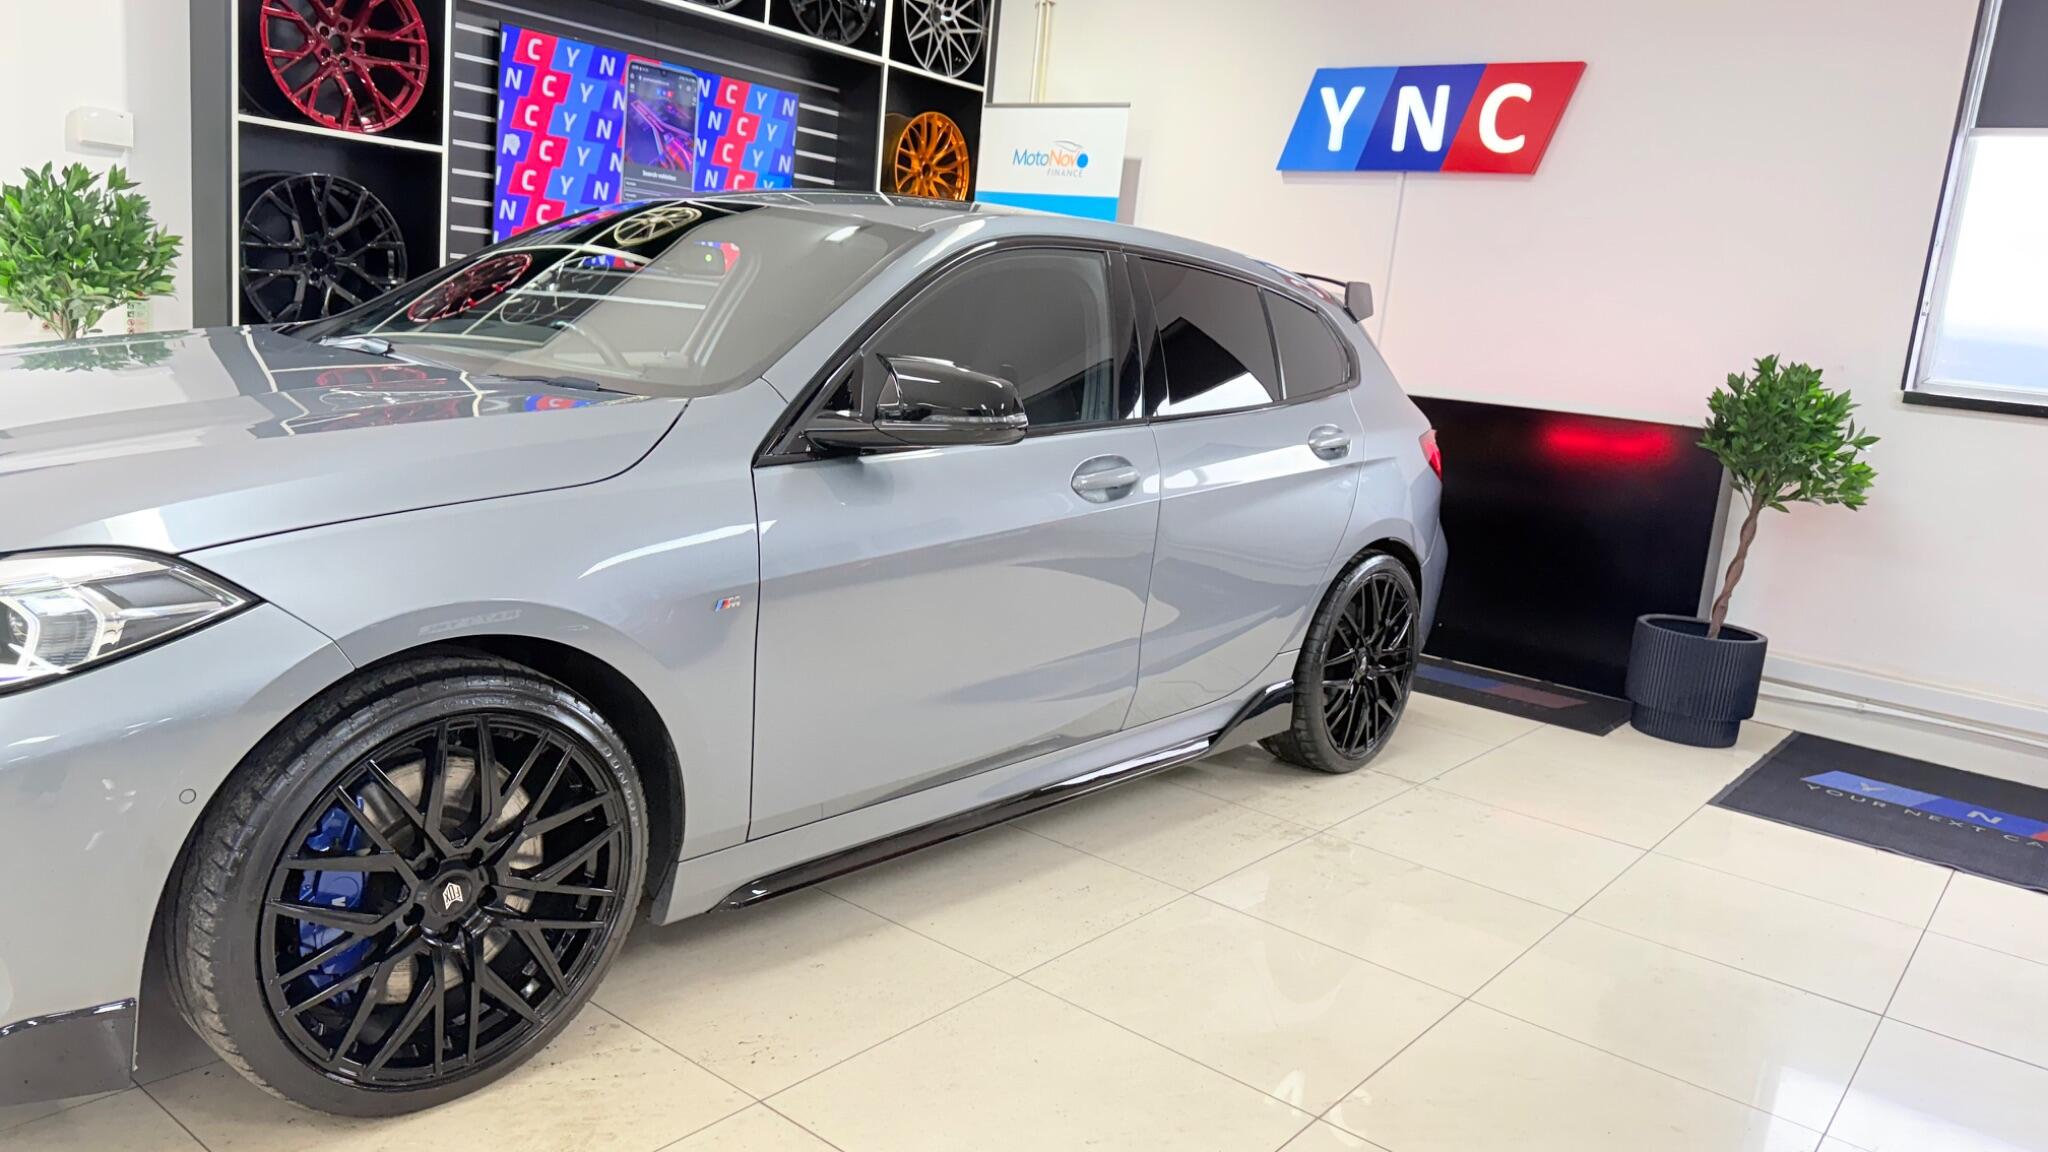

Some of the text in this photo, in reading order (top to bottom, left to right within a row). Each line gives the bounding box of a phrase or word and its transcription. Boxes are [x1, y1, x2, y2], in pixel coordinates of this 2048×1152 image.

[1320, 82, 1533, 154] YNC
[1046, 168, 1084, 178] FINANCE
[1806, 783, 1887, 808] YOUR
[1904, 808, 1986, 833] NEXT
